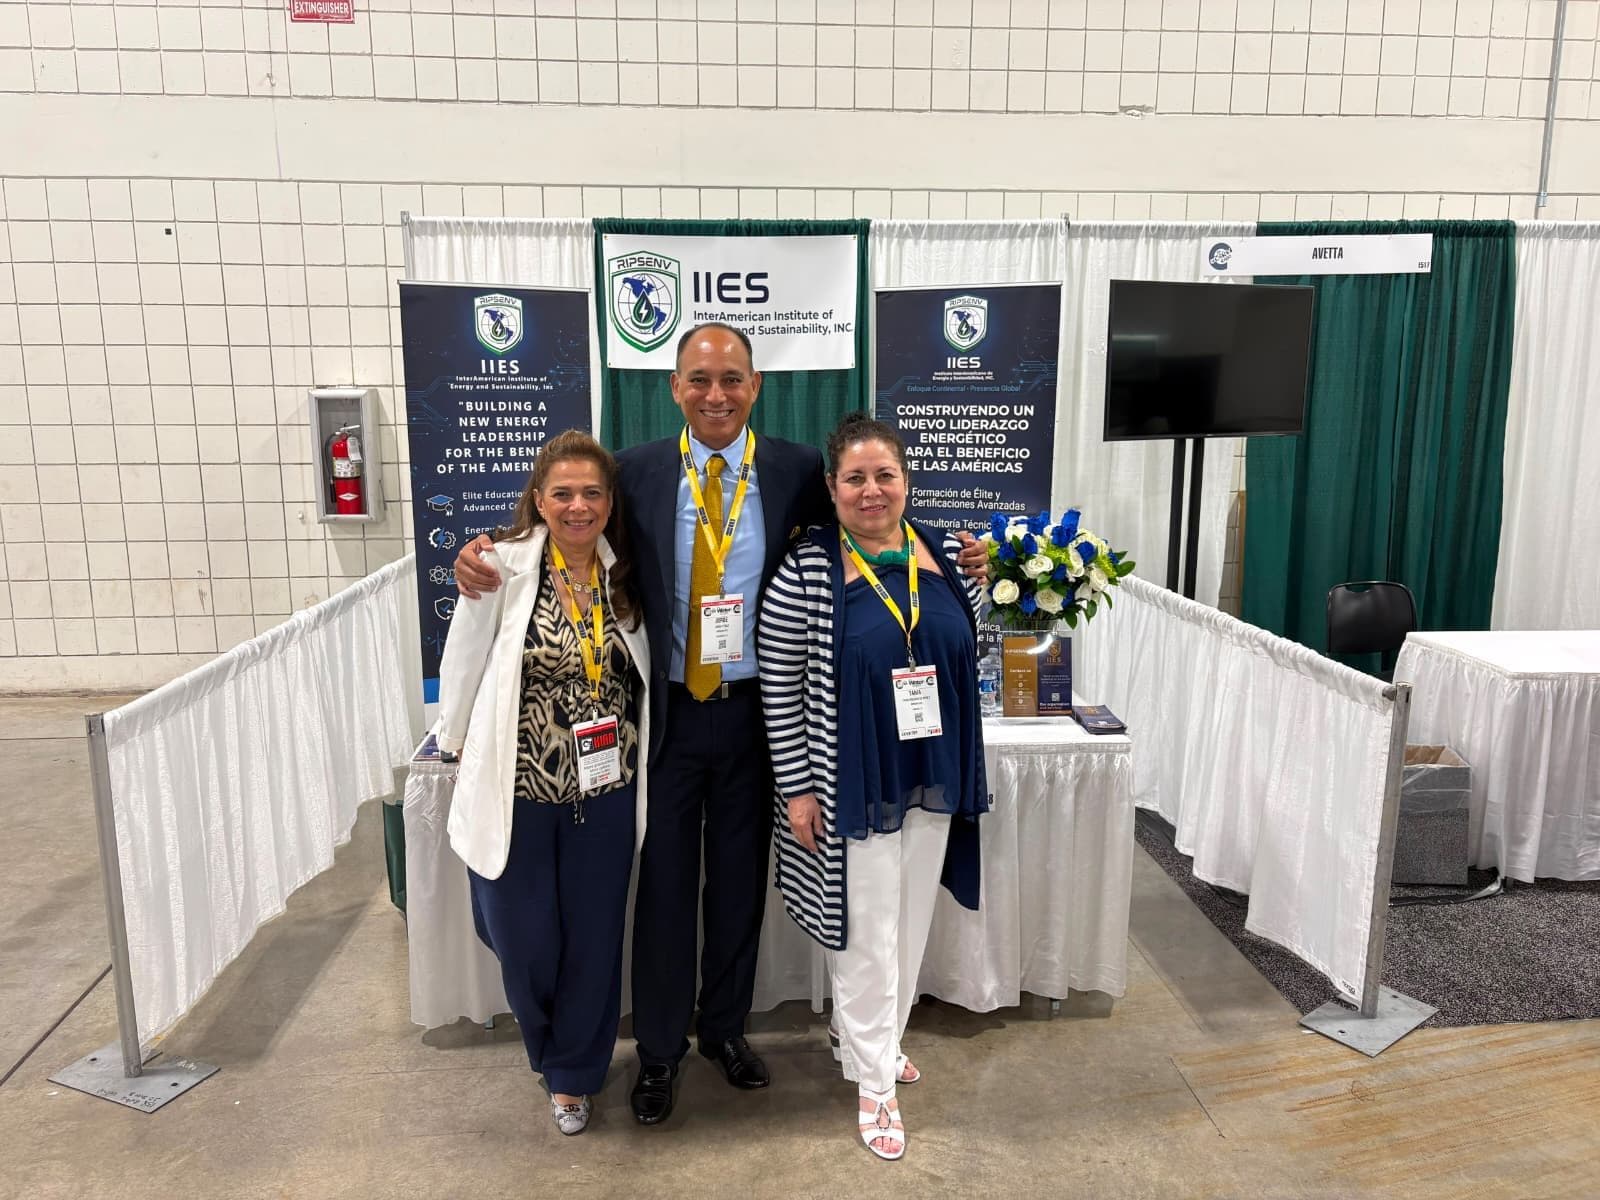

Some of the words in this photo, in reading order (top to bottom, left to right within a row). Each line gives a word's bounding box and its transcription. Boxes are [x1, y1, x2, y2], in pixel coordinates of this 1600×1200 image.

[295, 1, 349, 15] EXTINGUISHER
[1311, 247, 1343, 260] AVETTA
[616, 256, 672, 270] RIPSENV
[693, 271, 770, 304] IIES
[693, 310, 769, 322] InterAmerican
[774, 310, 819, 321] Institute
[822, 309, 834, 320] of
[740, 324, 755, 336] nd
[758, 324, 831, 336] Sustainability,
[481, 359, 520, 374] IIES
[947, 357, 981, 369] IIES
[450, 383, 474, 391] Energy
[491, 383, 541, 391] Sustainability,
[458, 401, 532, 412] "BUILDING
[538, 402, 547, 411] A
[897, 404, 1010, 417] CONSTRUYENDO
[1014, 405, 1035, 416] UN
[459, 417, 490, 427] NEW
[496, 416, 548, 427] ENERGY
[898, 418, 946, 430] NUEVO
[950, 419, 1029, 431] LIDERAZGO
[462, 431, 546, 442] LEADERSHIP
[919, 430, 1007, 445] ENERGÉTICO
[446, 448, 472, 458] FOR
[477, 447, 504, 457] THE
[905, 447, 933, 458] ARA
[937, 447, 953, 458] EL
[956, 448, 1030, 460] BENEFICIO
[436, 463, 455, 474] OF
[460, 463, 486, 473] THE
[492, 462, 534, 473] AMERI
[923, 460, 948, 472] LAS
[951, 458, 1023, 473] AMÉRICAS
[462, 491, 482, 500] Elite
[485, 490, 524, 499] Educatio
[912, 487, 959, 498] Formación
[960, 488, 972, 498] de
[974, 486, 994, 499] Élite
[995, 490, 1001, 501] y
[463, 503, 506, 512] Advanced
[911, 497, 976, 509] Certificaciones
[977, 500, 1026, 511] Avanzadas
[963, 518, 992, 530] Técnic
[986, 632, 995, 642] la
